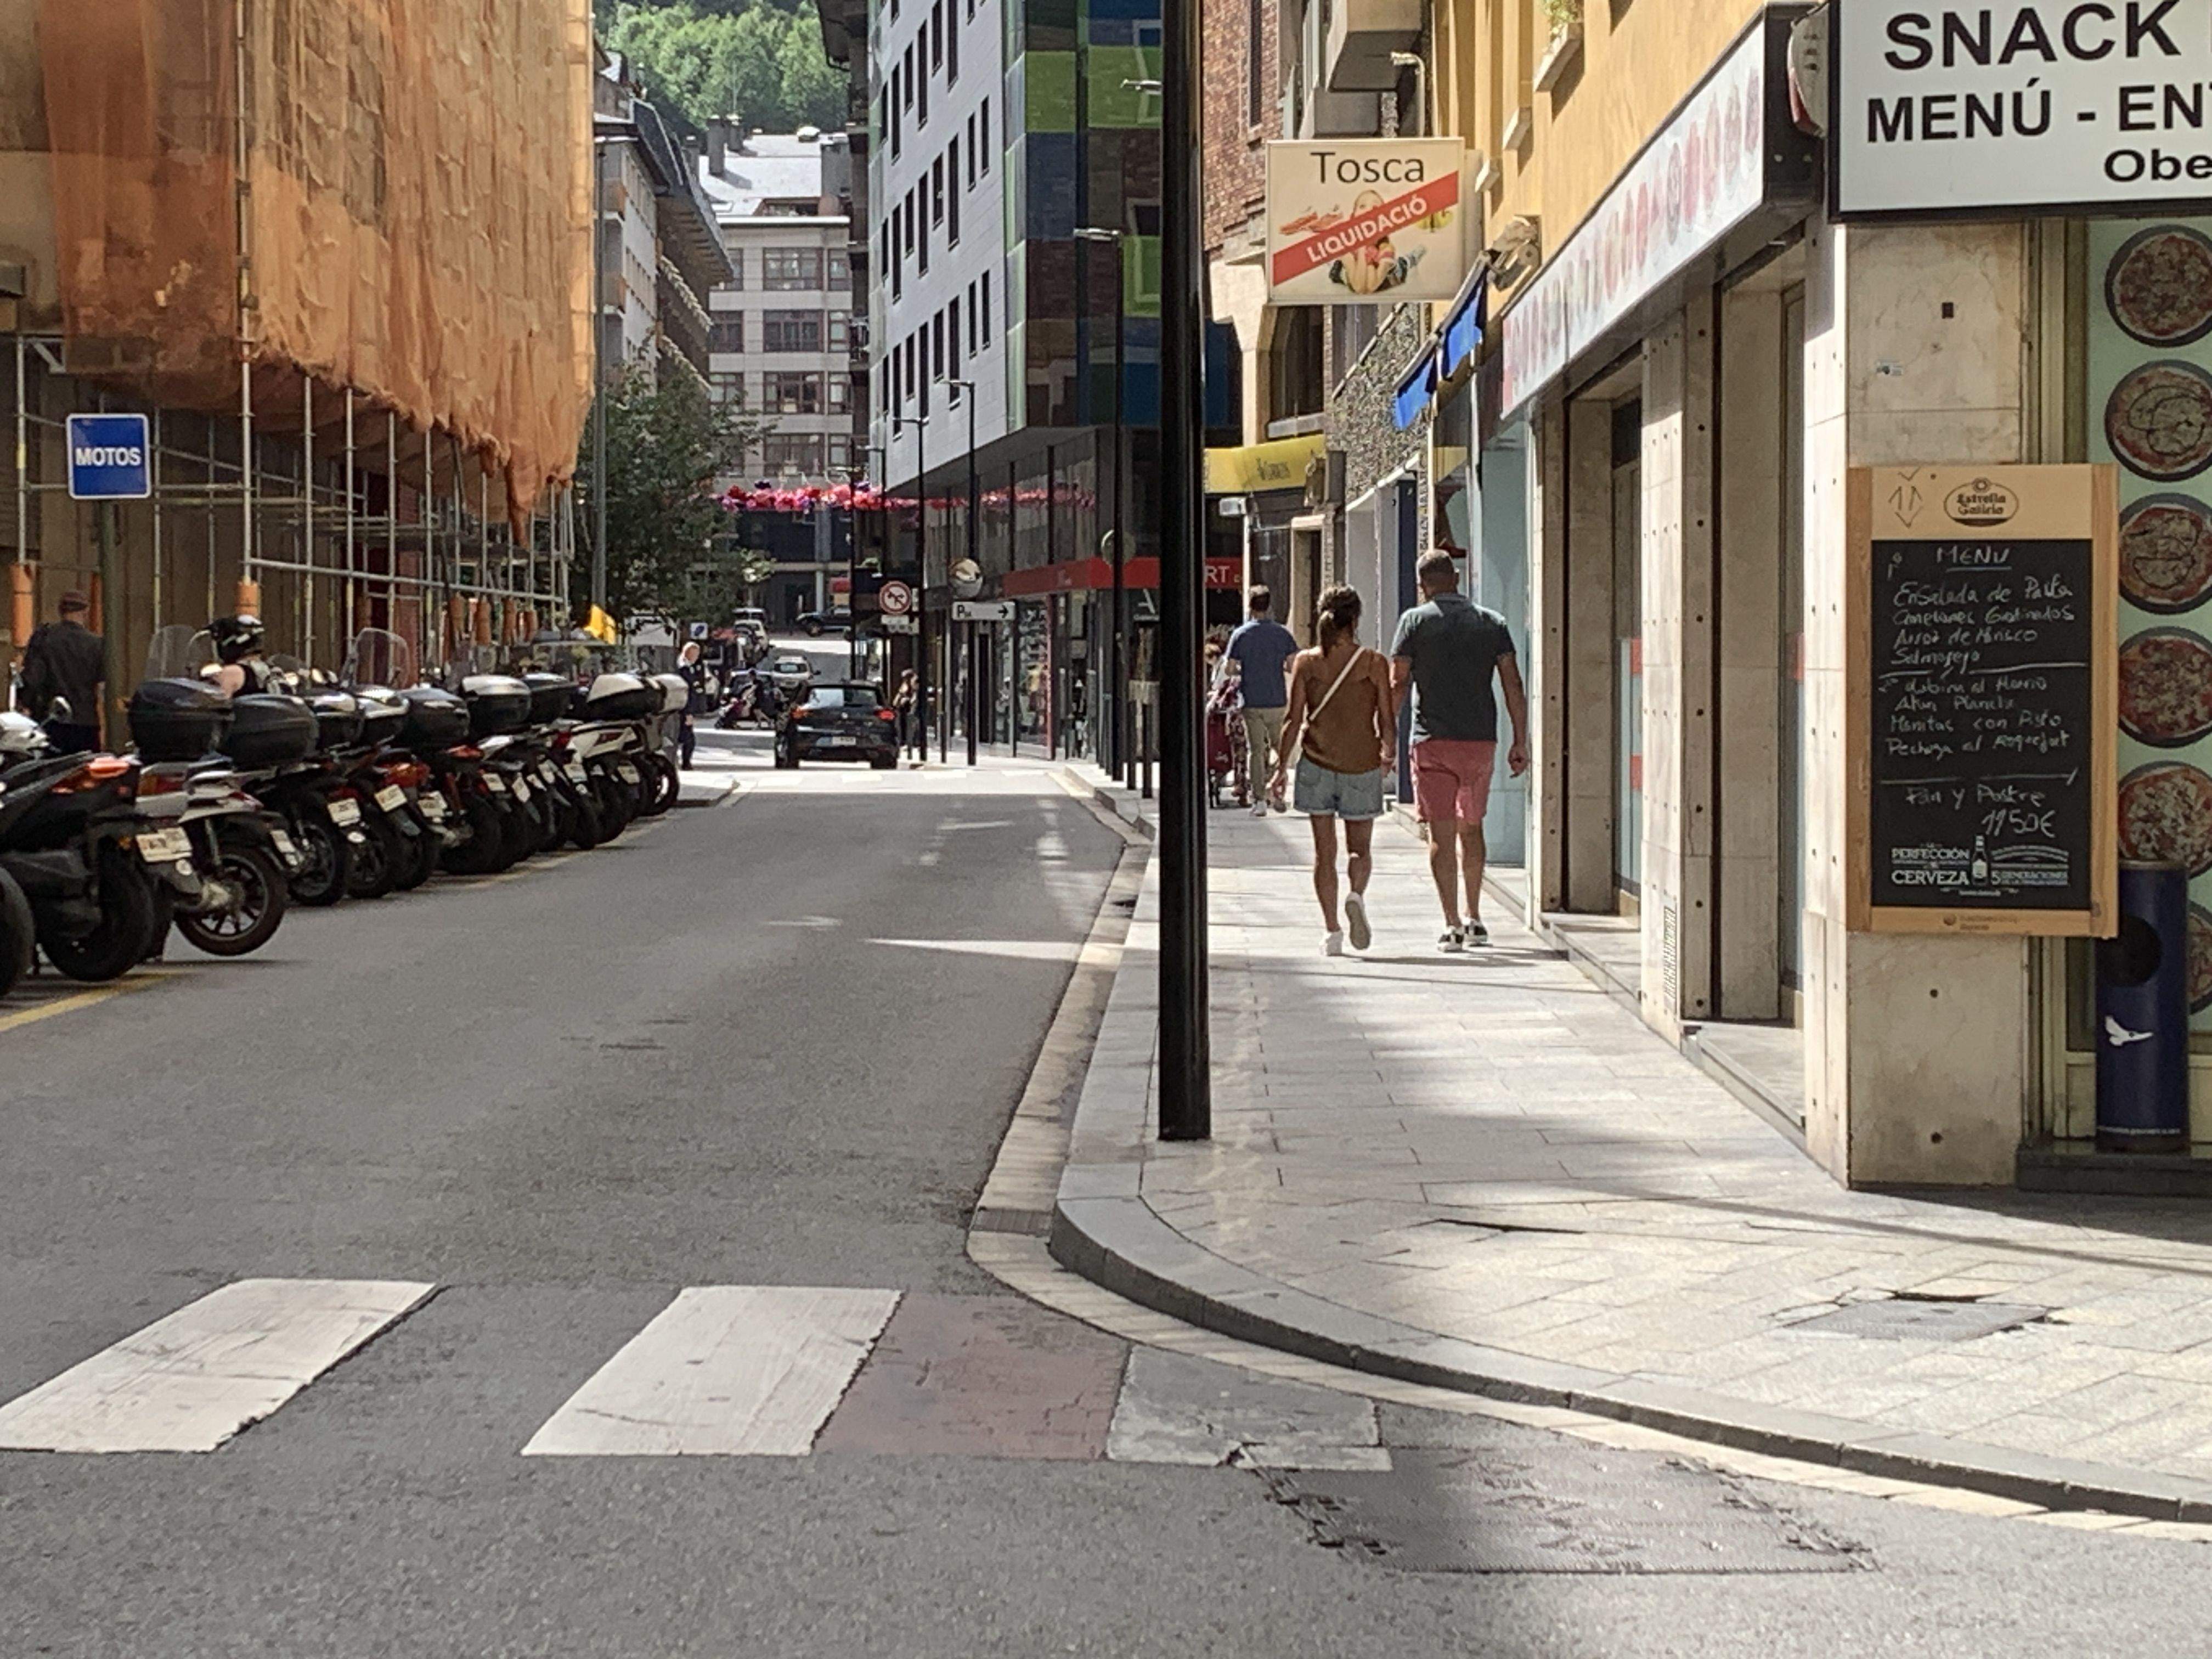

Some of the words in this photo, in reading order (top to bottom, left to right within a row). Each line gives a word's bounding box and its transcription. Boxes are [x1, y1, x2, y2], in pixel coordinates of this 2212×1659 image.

[1884, 0, 2182, 70] SNACK
[1867, 77, 2051, 143] MENÚ
[2119, 81, 2212, 132] EN
[1310, 151, 1425, 183] Tosca
[1306, 194, 1427, 263] LIQUIDACIÓ
[75, 447, 142, 466] MOTOS
[1891, 870, 1971, 886] CERVEZA
